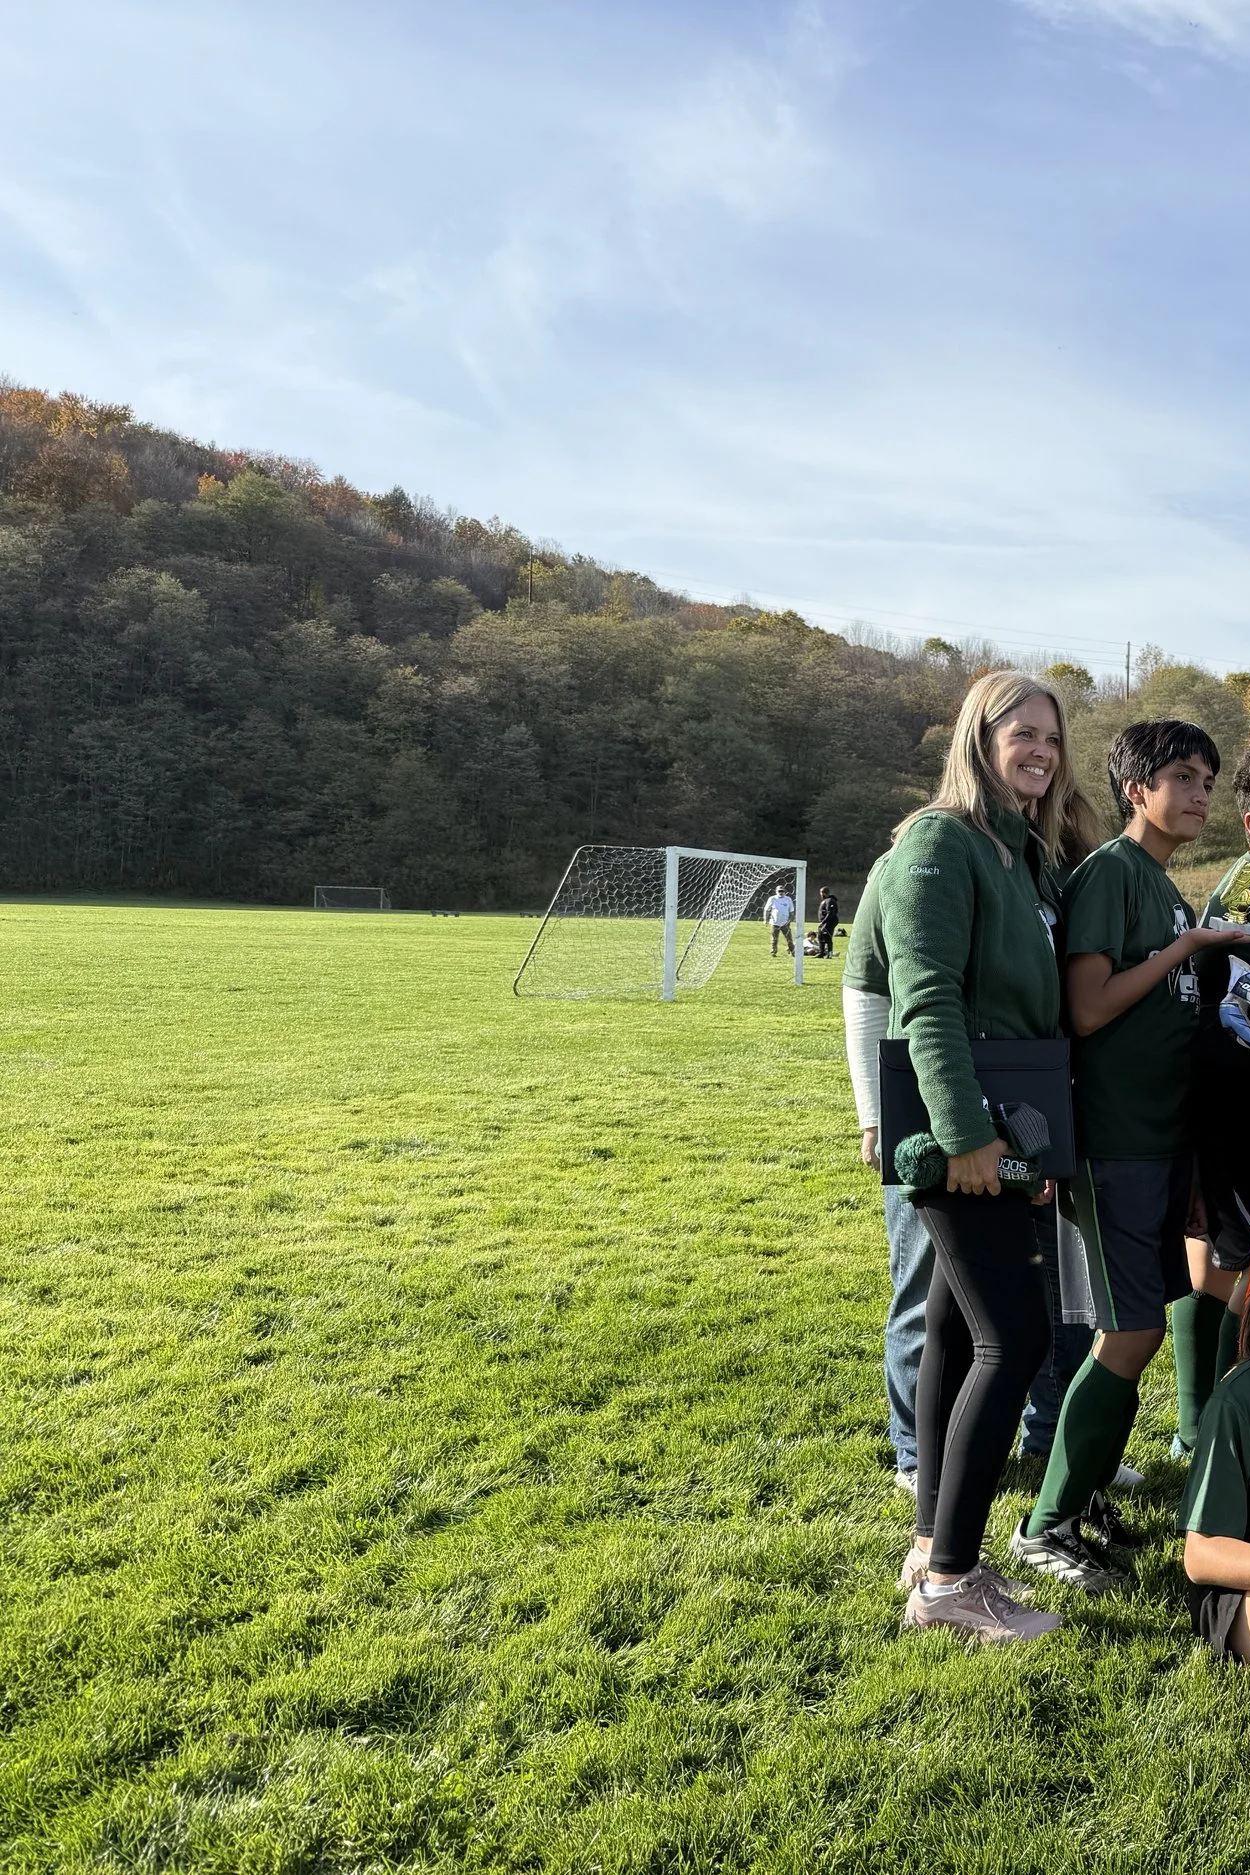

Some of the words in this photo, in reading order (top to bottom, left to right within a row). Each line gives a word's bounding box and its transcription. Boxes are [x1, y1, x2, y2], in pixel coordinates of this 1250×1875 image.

[909, 865, 940, 875] Coach
[999, 1157, 1028, 1173] SOCC
[999, 1171, 1030, 1181] GREE
